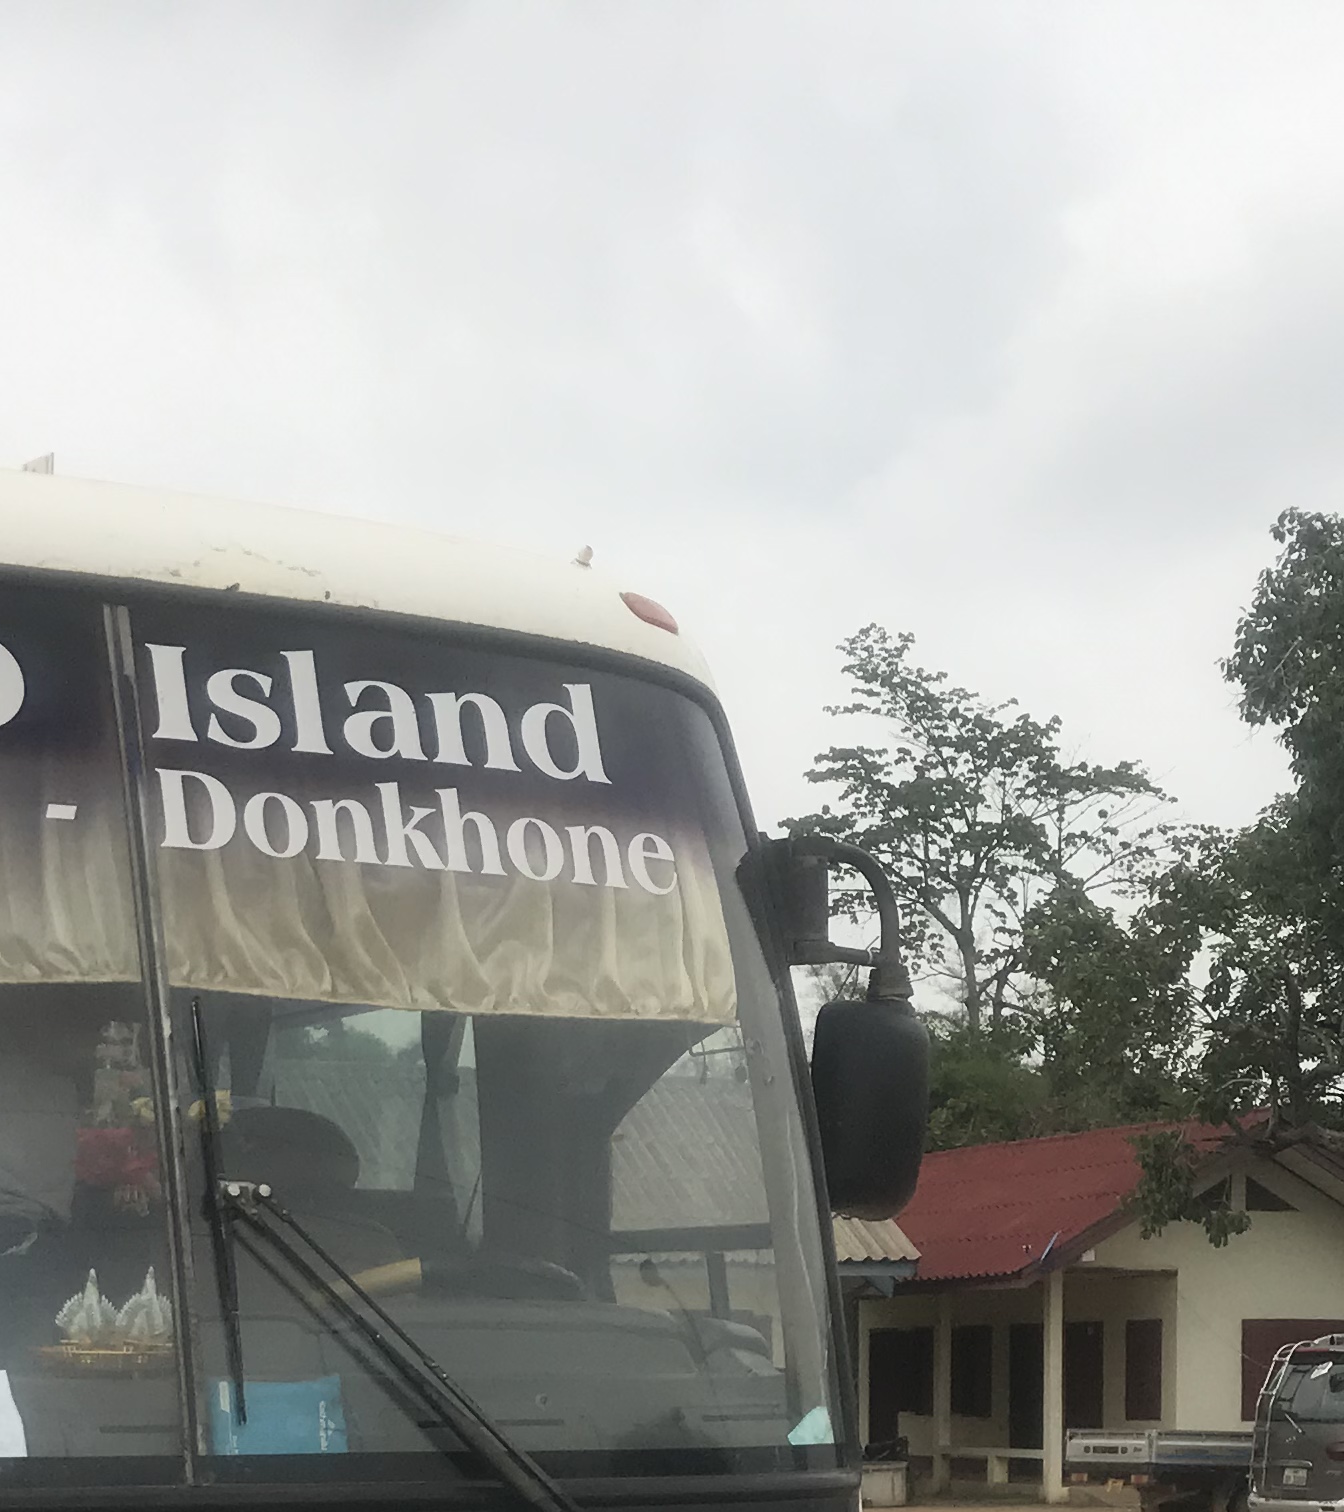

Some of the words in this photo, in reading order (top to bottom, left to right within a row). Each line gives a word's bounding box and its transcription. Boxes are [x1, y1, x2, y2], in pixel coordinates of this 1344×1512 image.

[145, 643, 612, 784] Island
[46, 803, 77, 820] -
[155, 768, 678, 895] Donkhone
